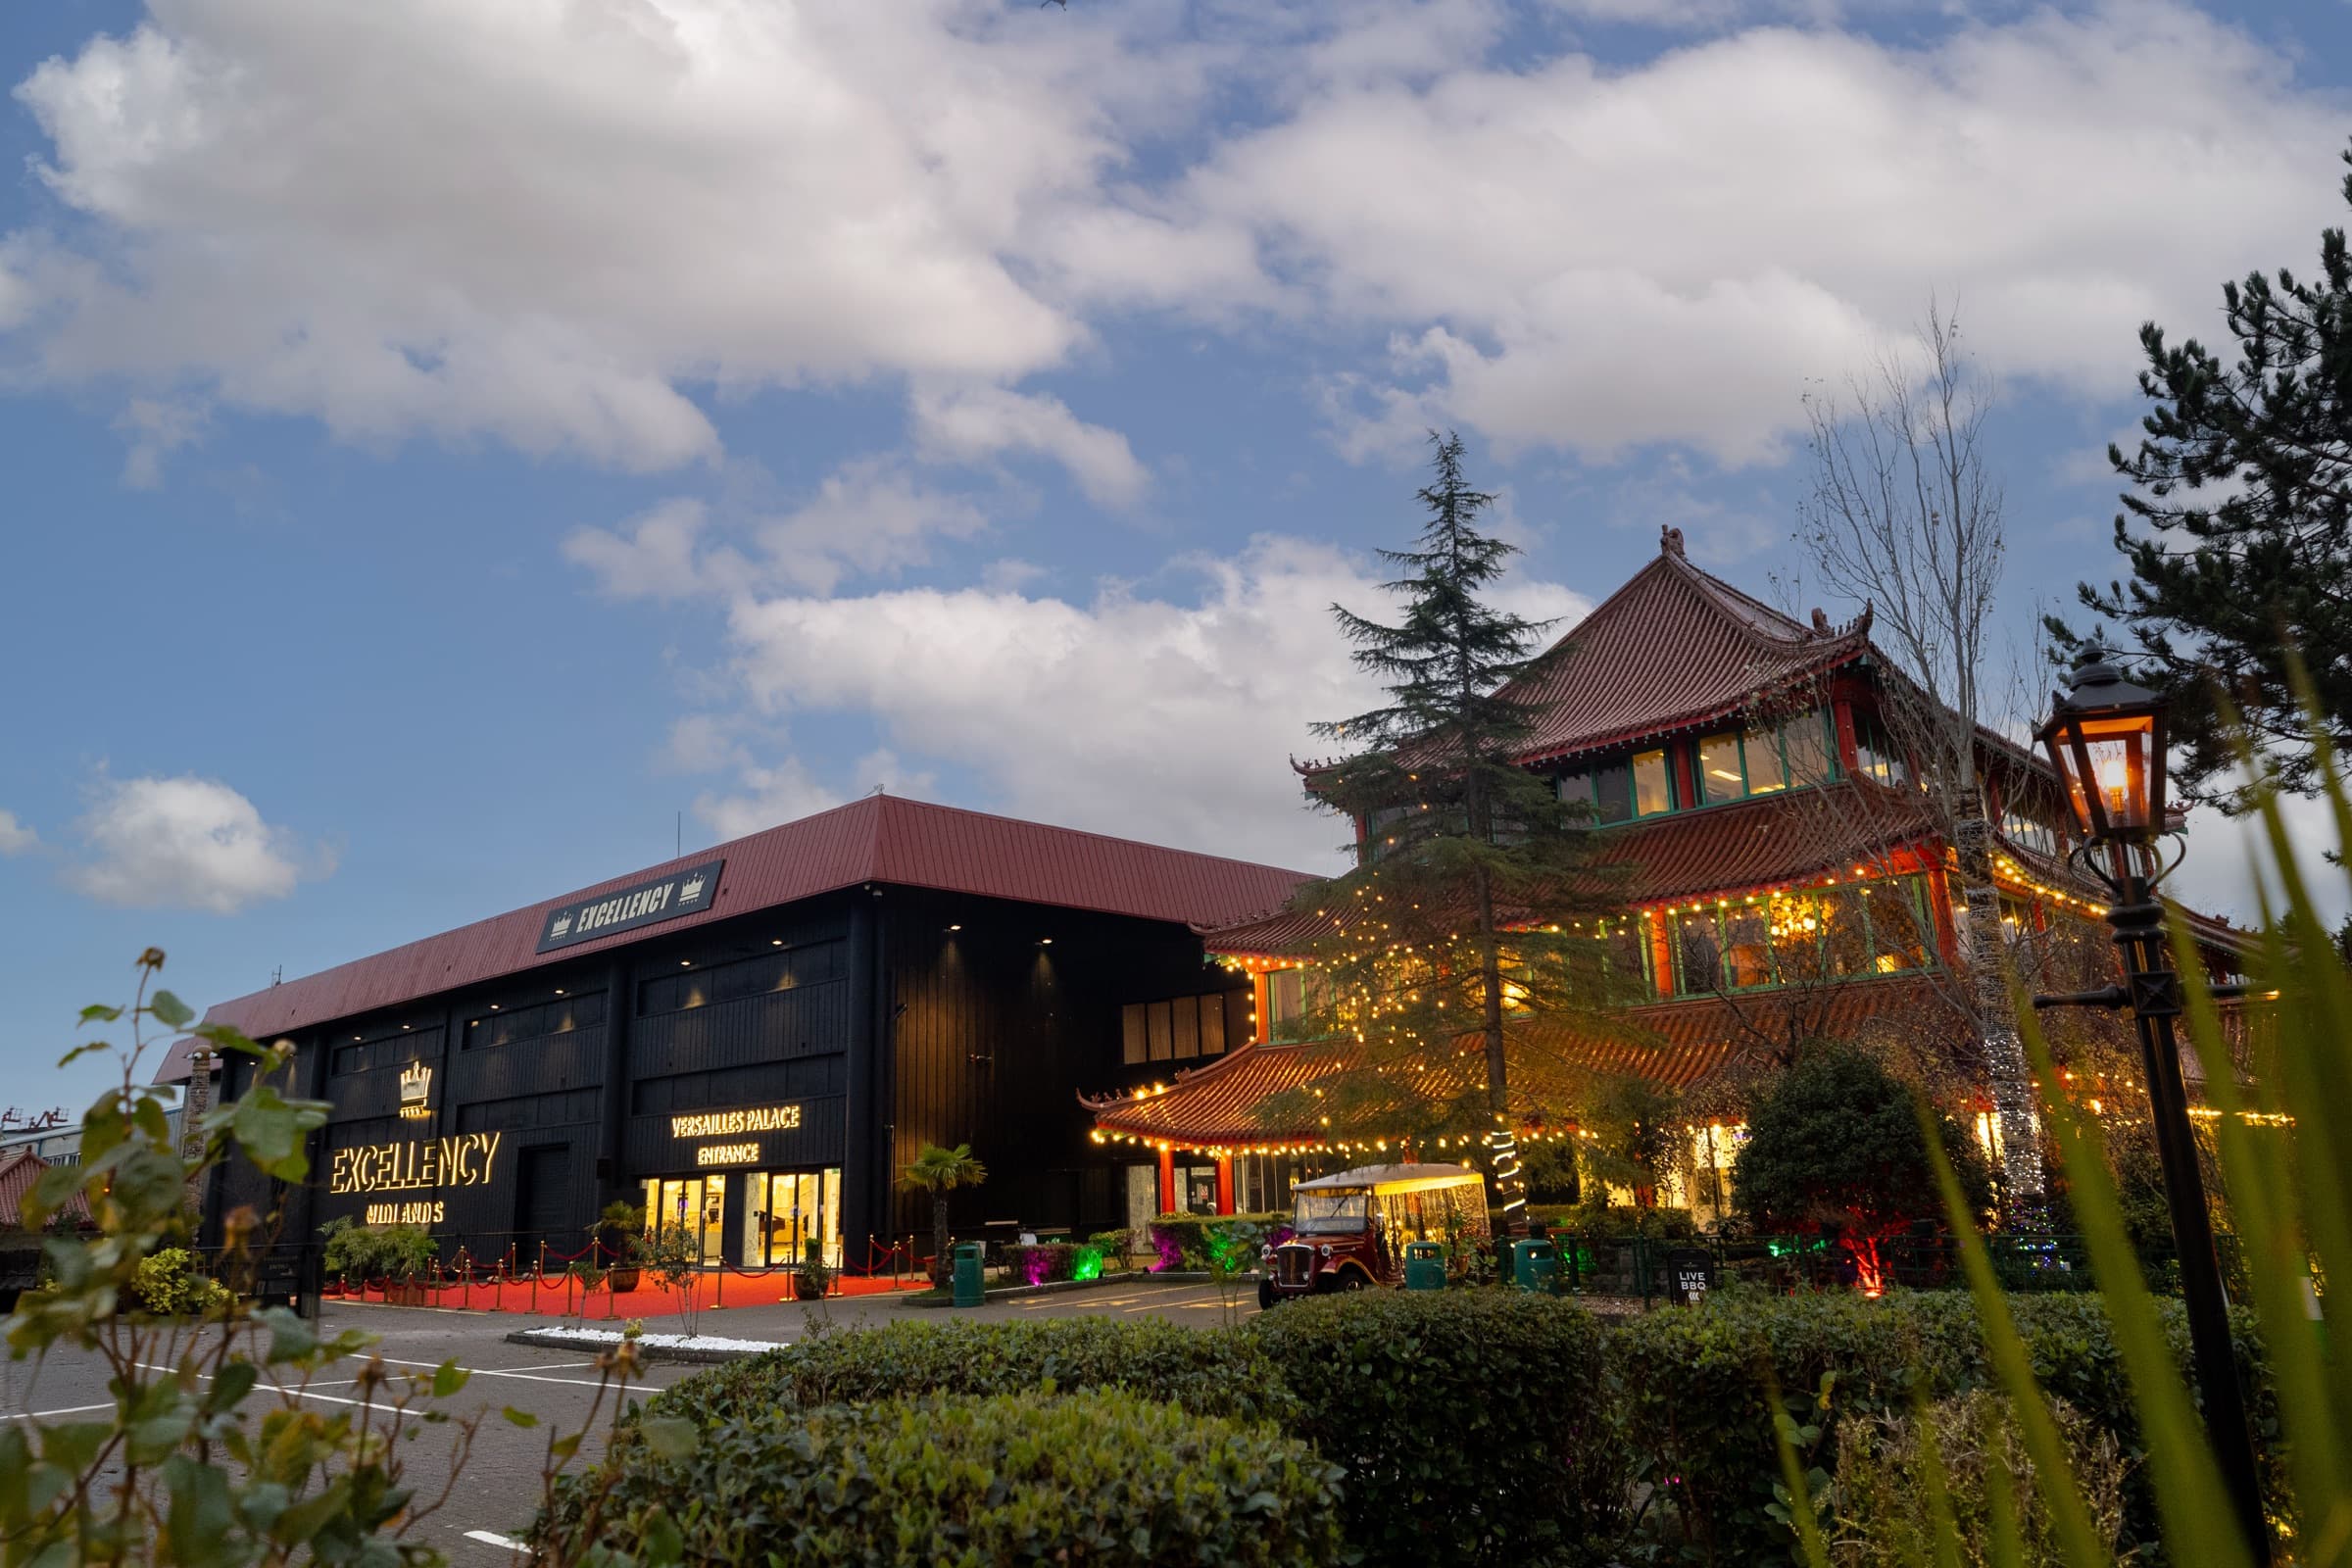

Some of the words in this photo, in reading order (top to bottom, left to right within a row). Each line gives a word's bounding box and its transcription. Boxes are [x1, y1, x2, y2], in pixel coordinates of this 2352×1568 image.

[575, 883, 674, 933] EXCELLENCY
[672, 1111, 745, 1138] VERSAILLES
[746, 1104, 801, 1132] PALACE
[329, 1131, 501, 1194] EXCELLENCY
[697, 1143, 760, 1165] ENTRANCE
[367, 1201, 445, 1225] MIDLANDS
[1679, 1272, 1705, 1281] LIVE
[1681, 1281, 1706, 1291] BBQ
